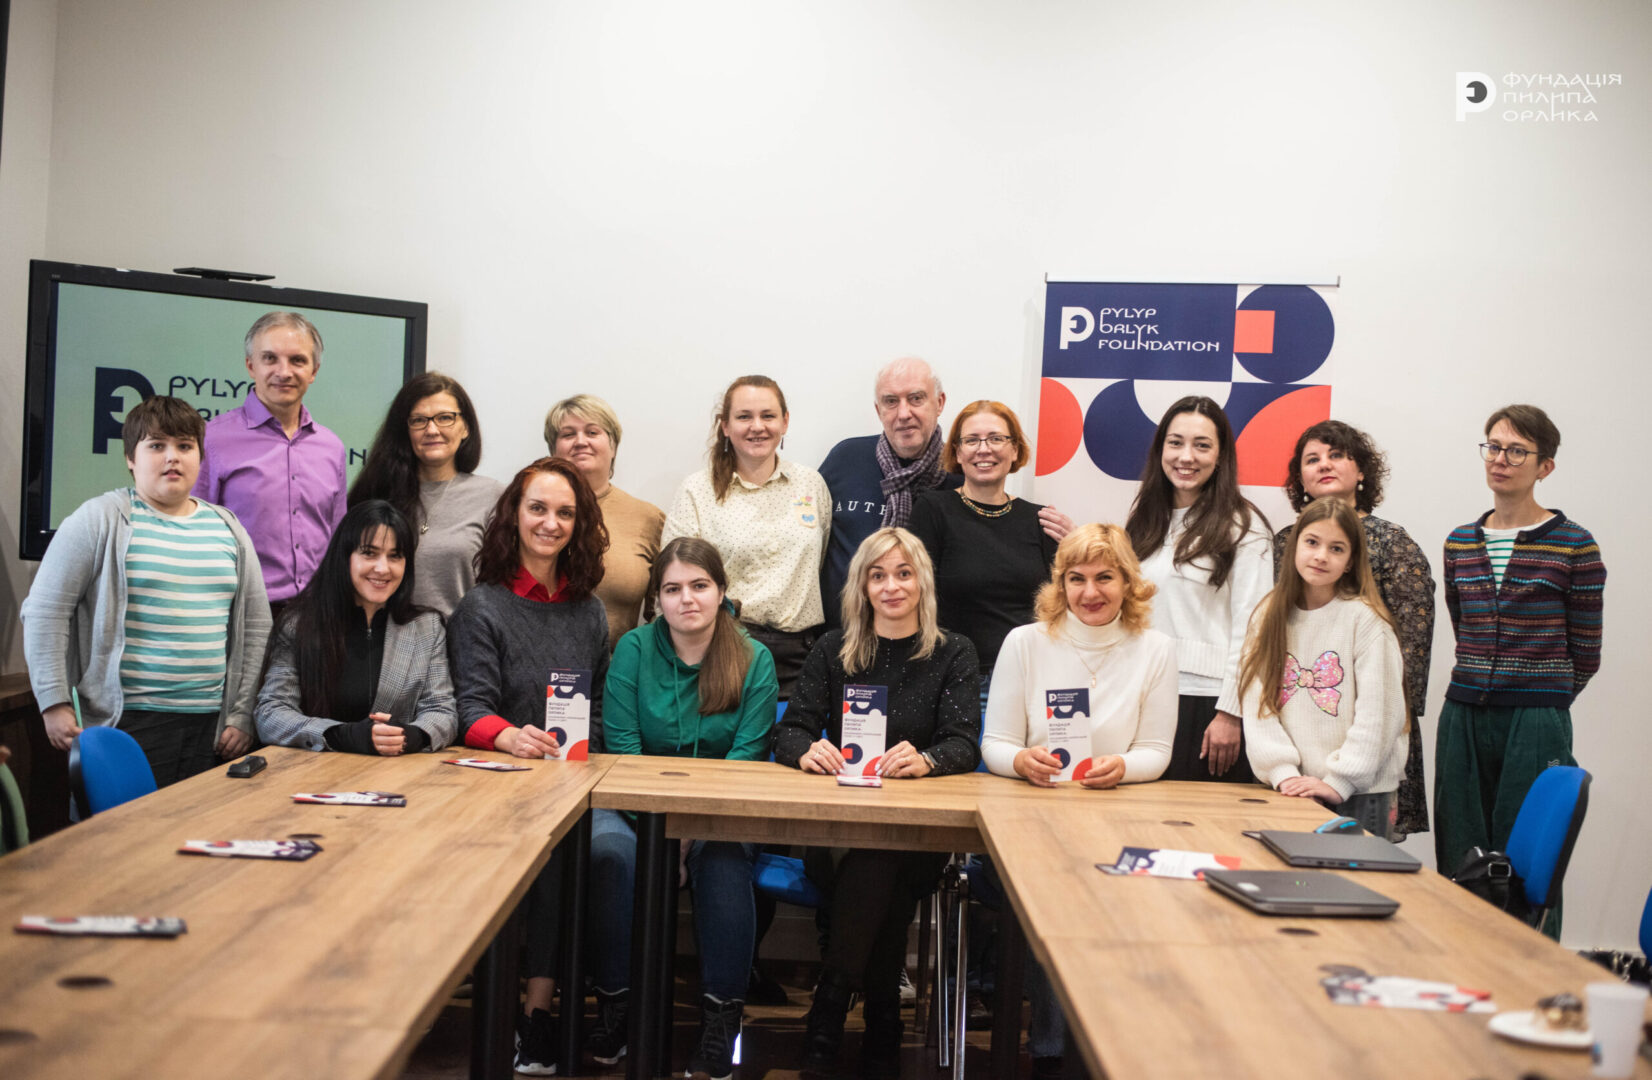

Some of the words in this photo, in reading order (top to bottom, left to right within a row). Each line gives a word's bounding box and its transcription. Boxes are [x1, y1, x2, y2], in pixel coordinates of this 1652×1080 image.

[1100, 308, 1157, 319] PYLYP
[1100, 323, 1160, 335] ORLYK
[1098, 339, 1220, 352] FOUNDATION
